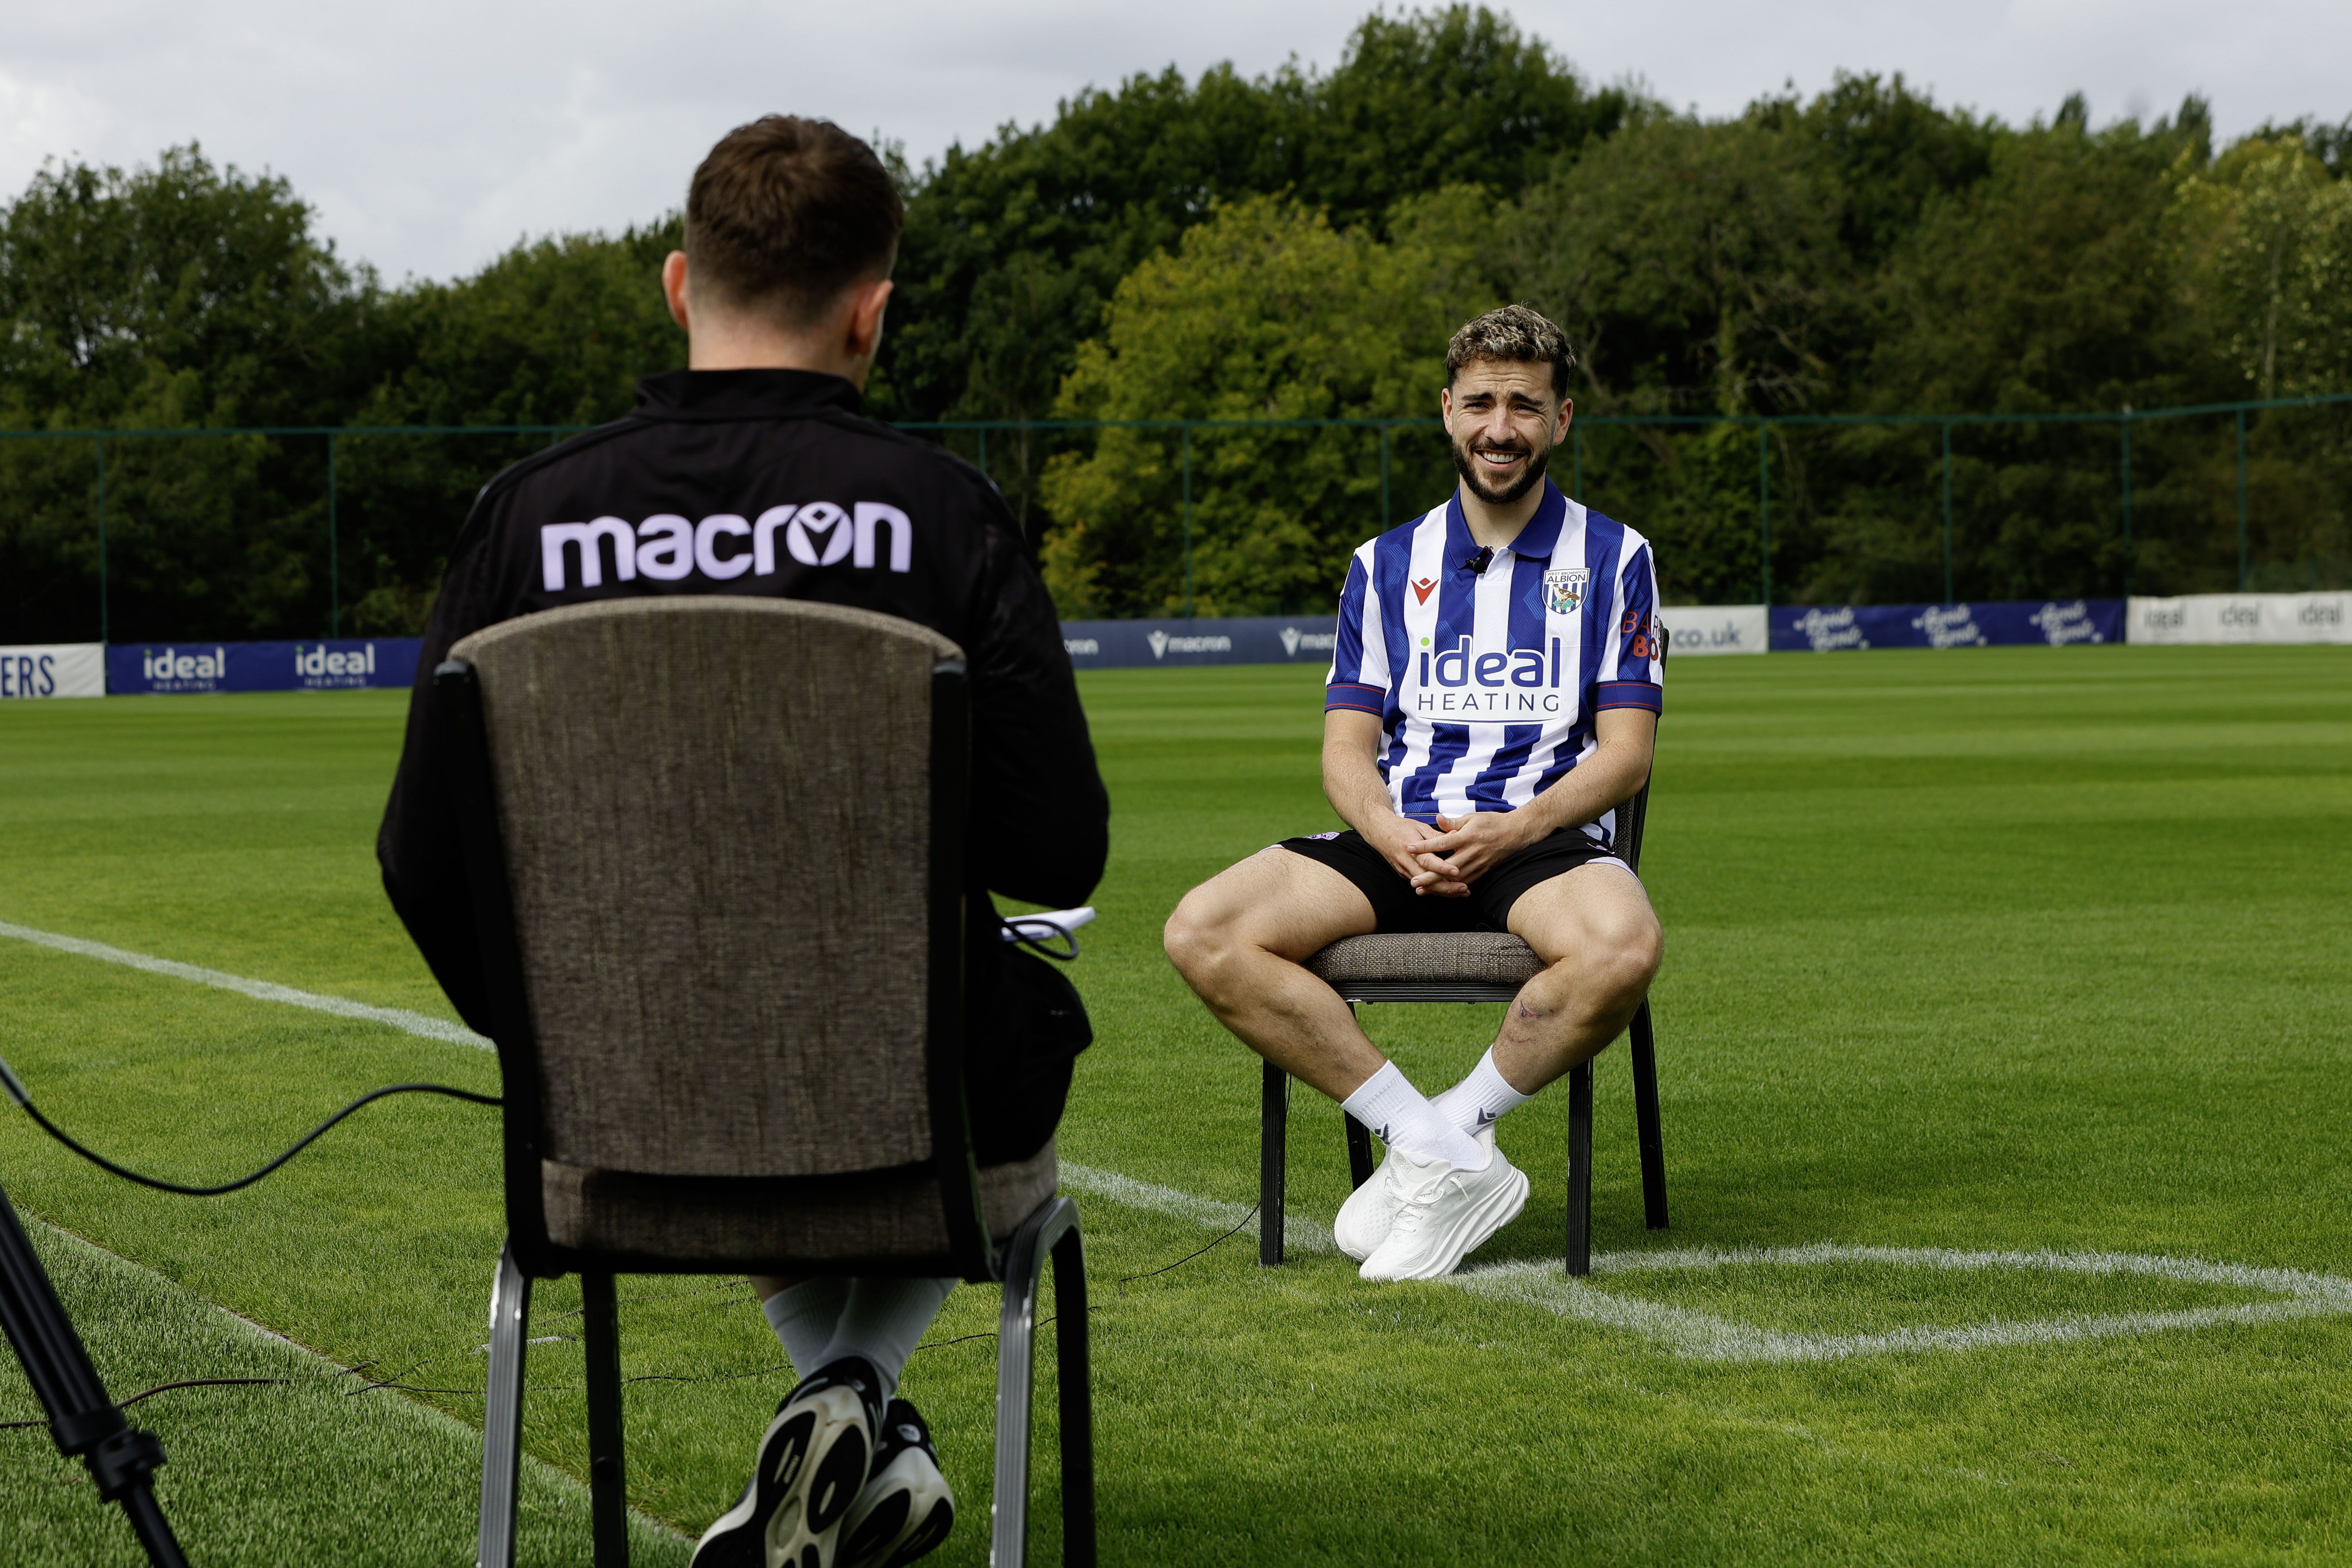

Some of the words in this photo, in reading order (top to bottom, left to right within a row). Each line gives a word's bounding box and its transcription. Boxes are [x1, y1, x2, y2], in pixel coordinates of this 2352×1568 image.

[541, 501, 912, 592] macron
[1547, 574, 1586, 583] ALBION
[144, 646, 226, 680] ideal
[295, 642, 375, 676] ideal
[1420, 637, 1560, 688] ideal
[1633, 634, 1662, 661] BO
[1, 655, 55, 696] ERS
[1418, 693, 1559, 712] HEATING
